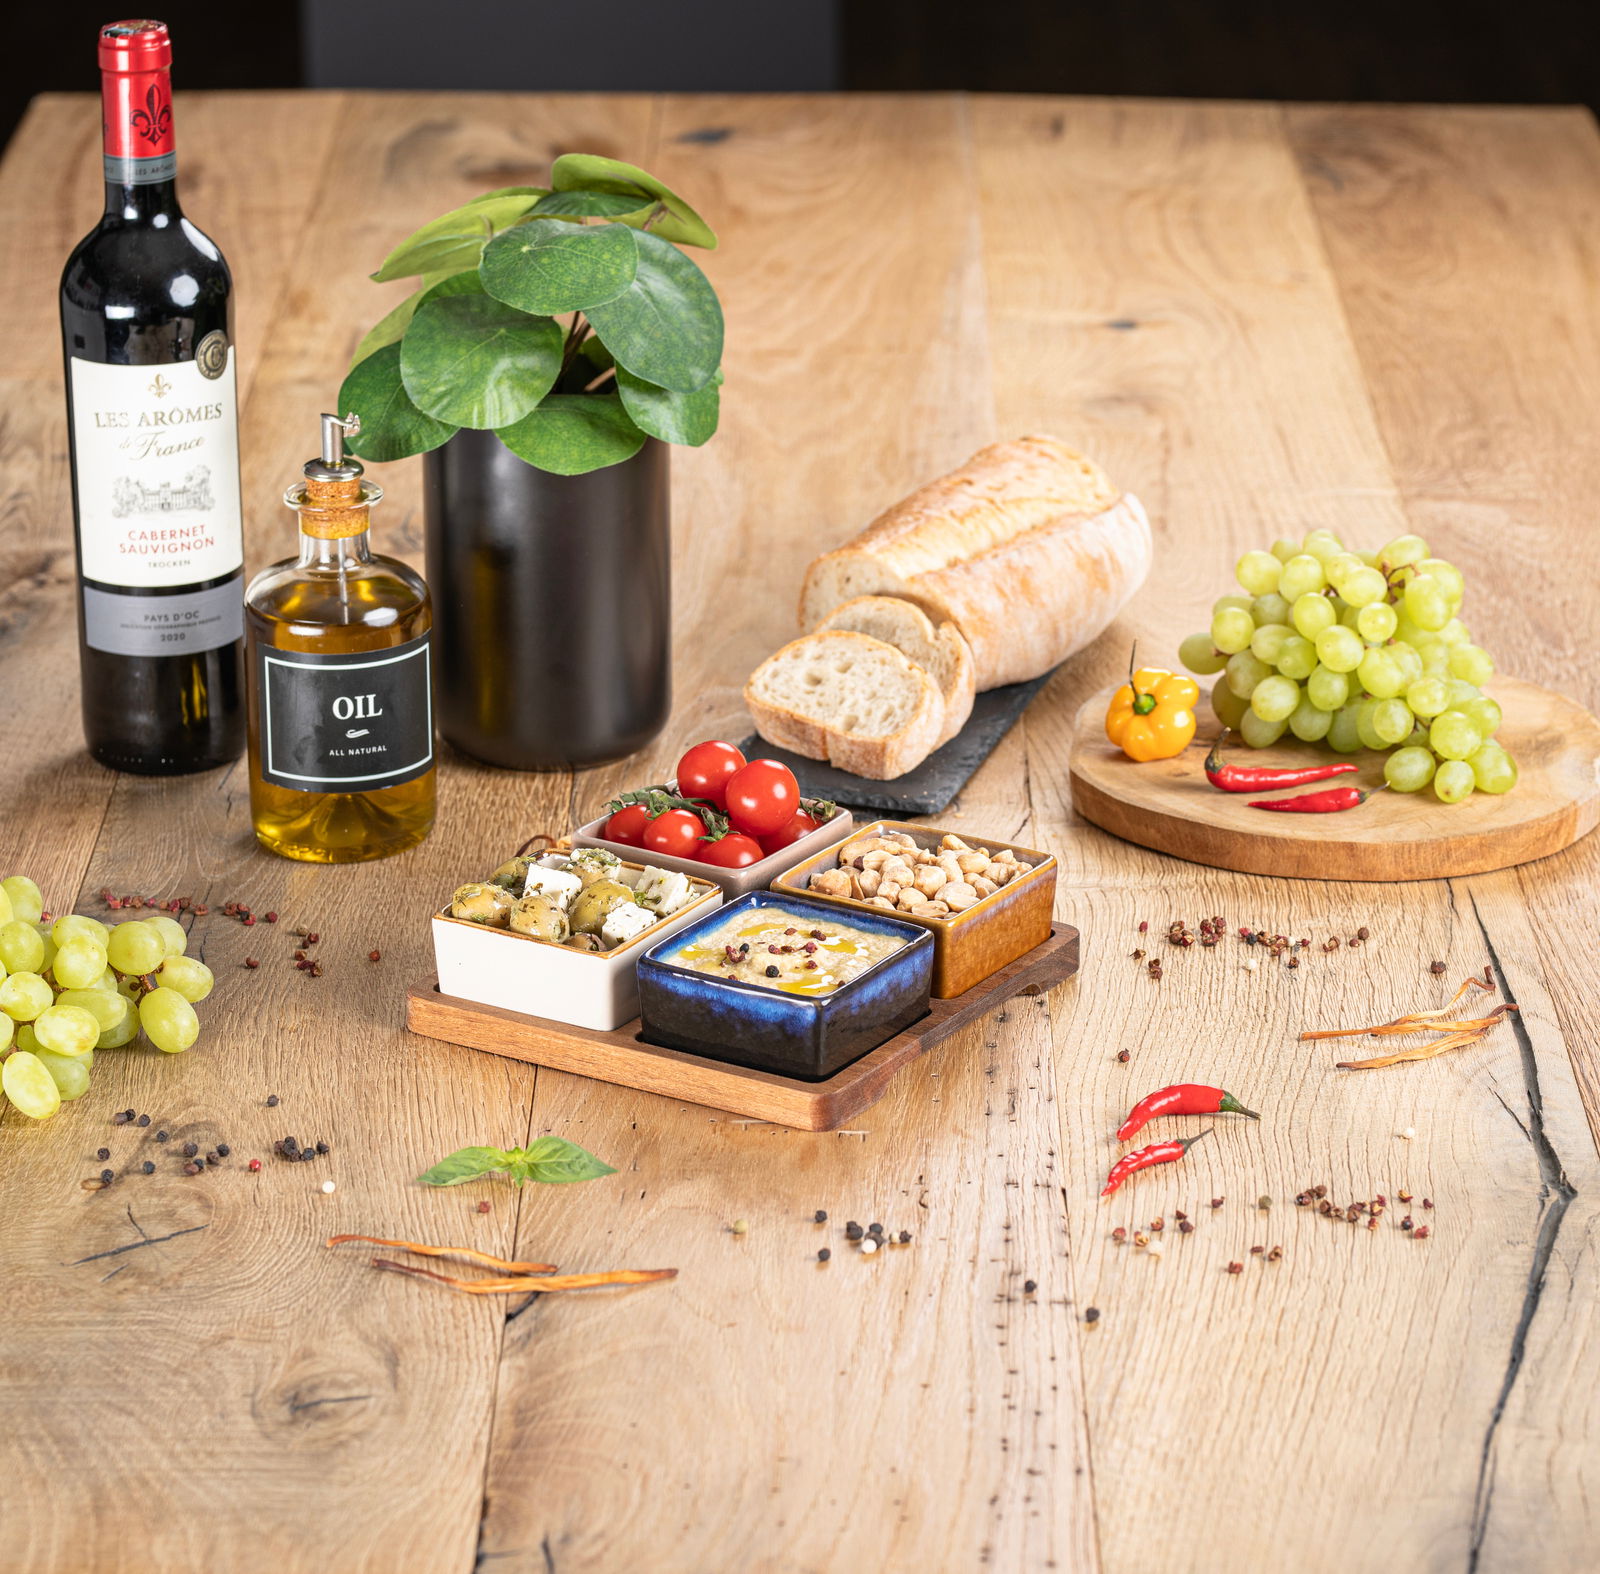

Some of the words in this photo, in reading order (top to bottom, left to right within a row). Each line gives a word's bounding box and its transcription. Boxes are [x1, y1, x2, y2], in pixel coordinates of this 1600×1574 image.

[94, 411, 129, 428] LES
[137, 402, 223, 427] ARÔMES
[119, 436, 131, 449] de
[129, 430, 206, 460] France
[128, 524, 205, 541] CABERNET
[119, 536, 214, 554] SAUVIGNON
[148, 559, 191, 568] TROCKEN
[144, 614, 169, 622] PAYS
[172, 610, 200, 621] D'OC
[160, 632, 186, 642] 2020
[332, 694, 383, 720] OIL
[348, 745, 387, 756] NATURAL
